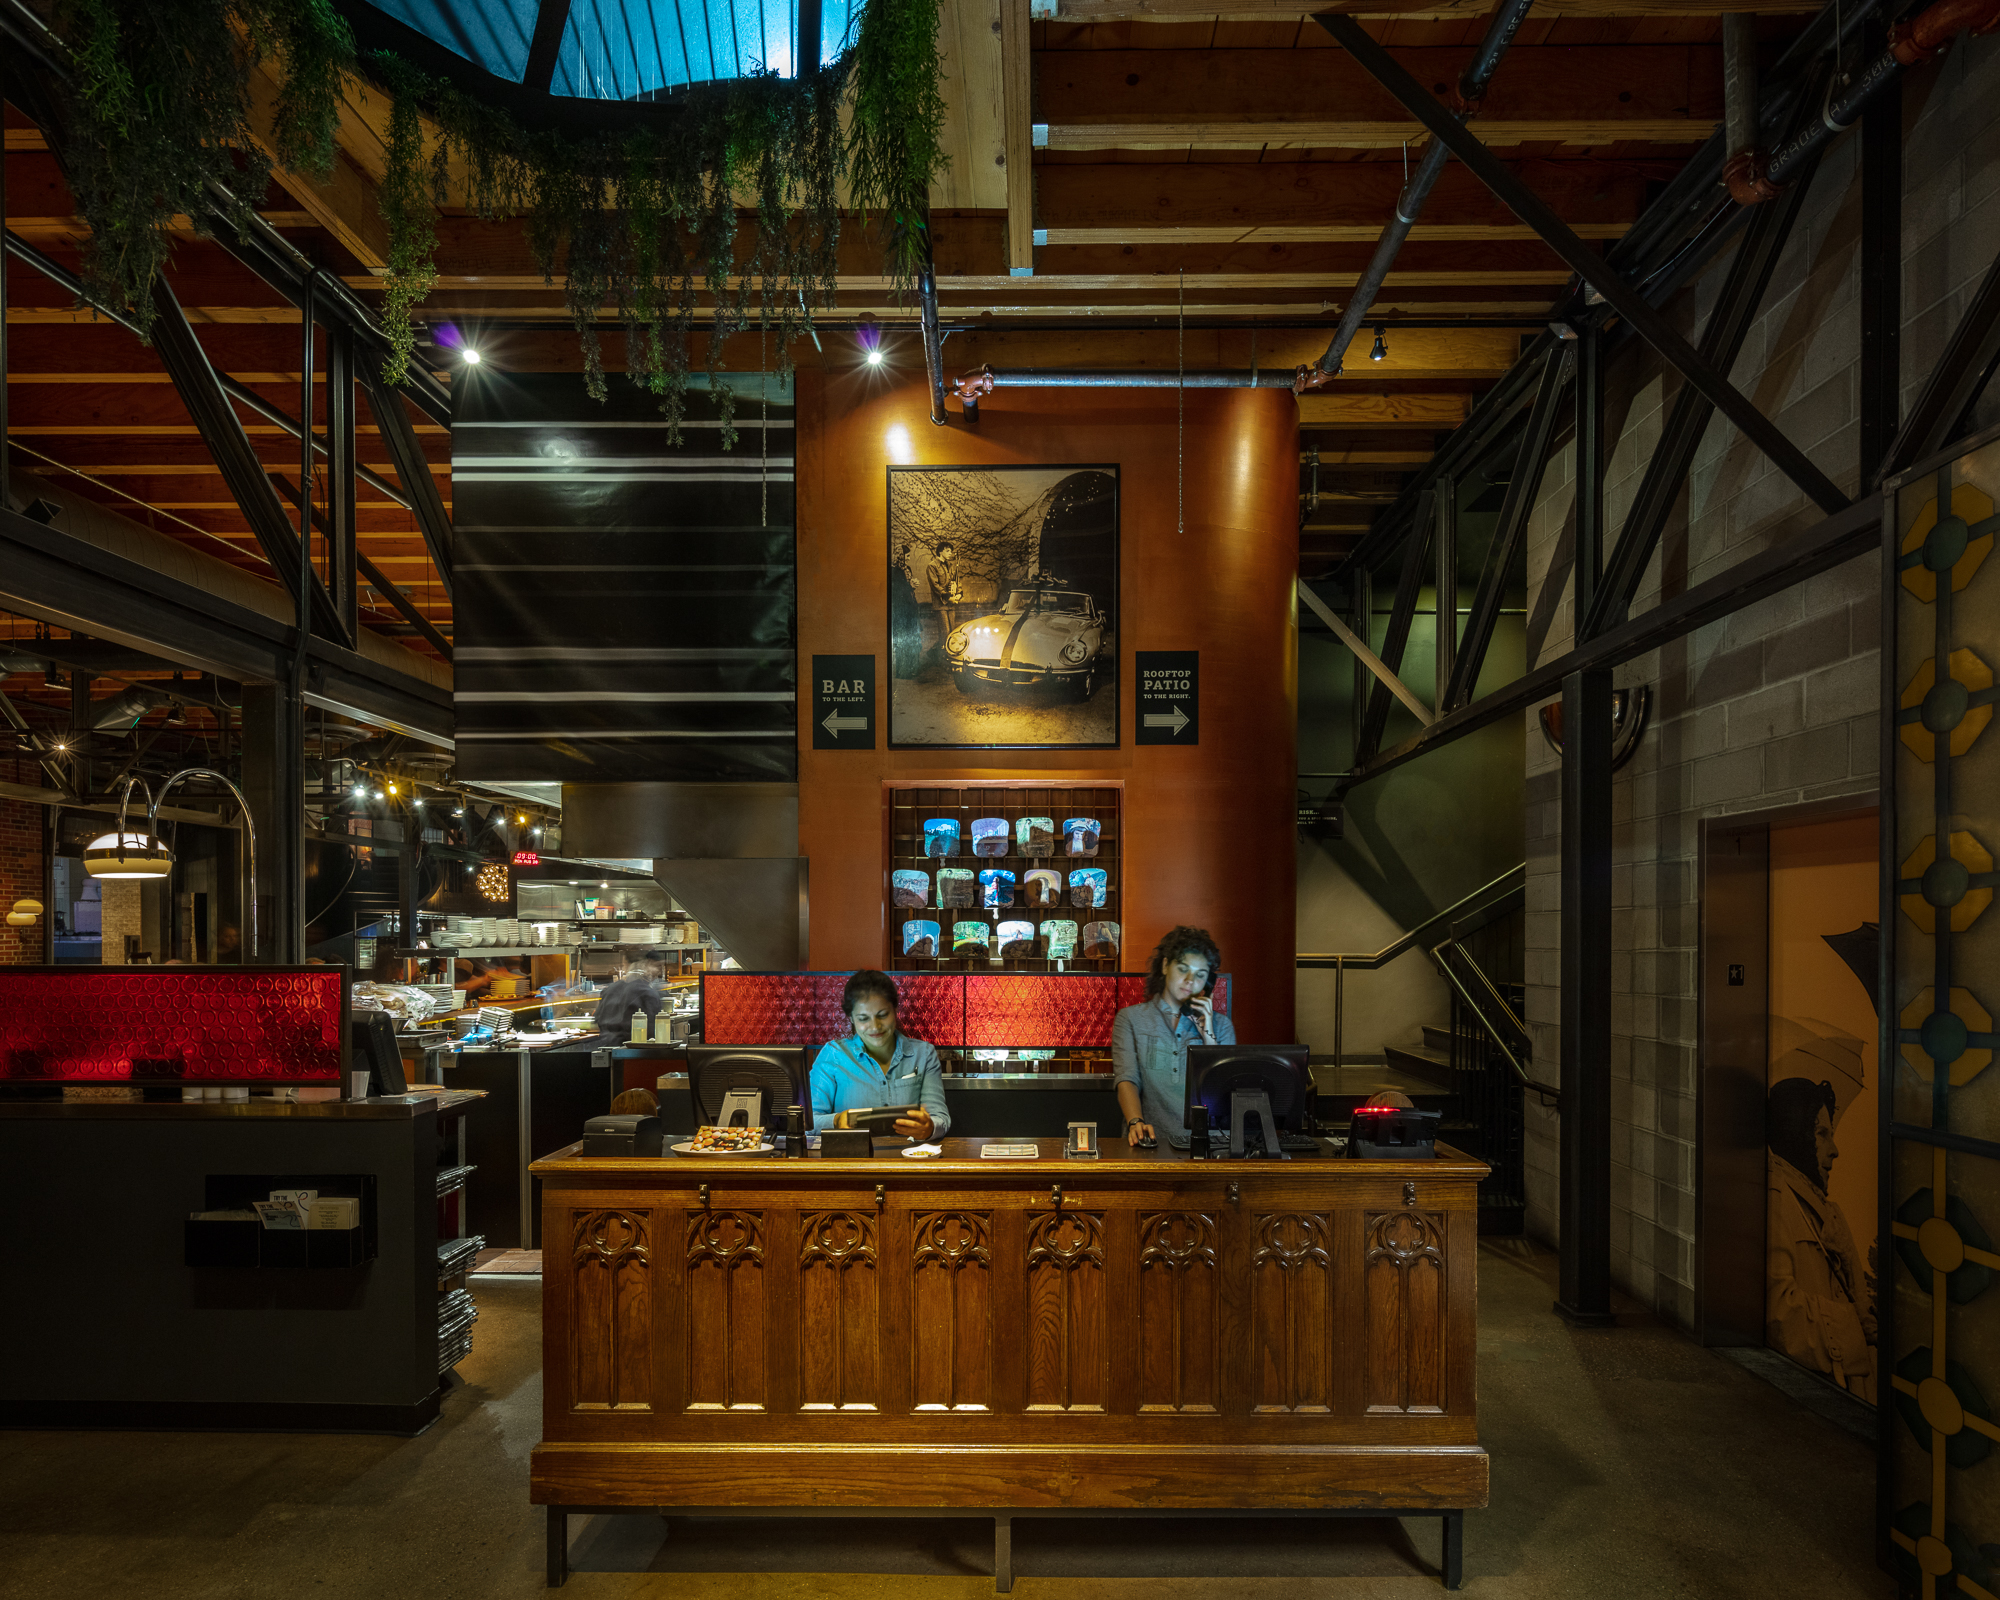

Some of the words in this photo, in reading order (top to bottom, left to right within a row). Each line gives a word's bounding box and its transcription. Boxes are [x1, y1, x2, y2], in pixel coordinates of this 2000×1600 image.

[1500, 0, 1532, 45] FIRE-F
[1769, 118, 1821, 173] GRADE
[1143, 670, 1191, 678] ROOFTOP
[822, 679, 866, 694] BAR
[1143, 680, 1191, 690] PATIO
[516, 852, 537, 860] 09:00
